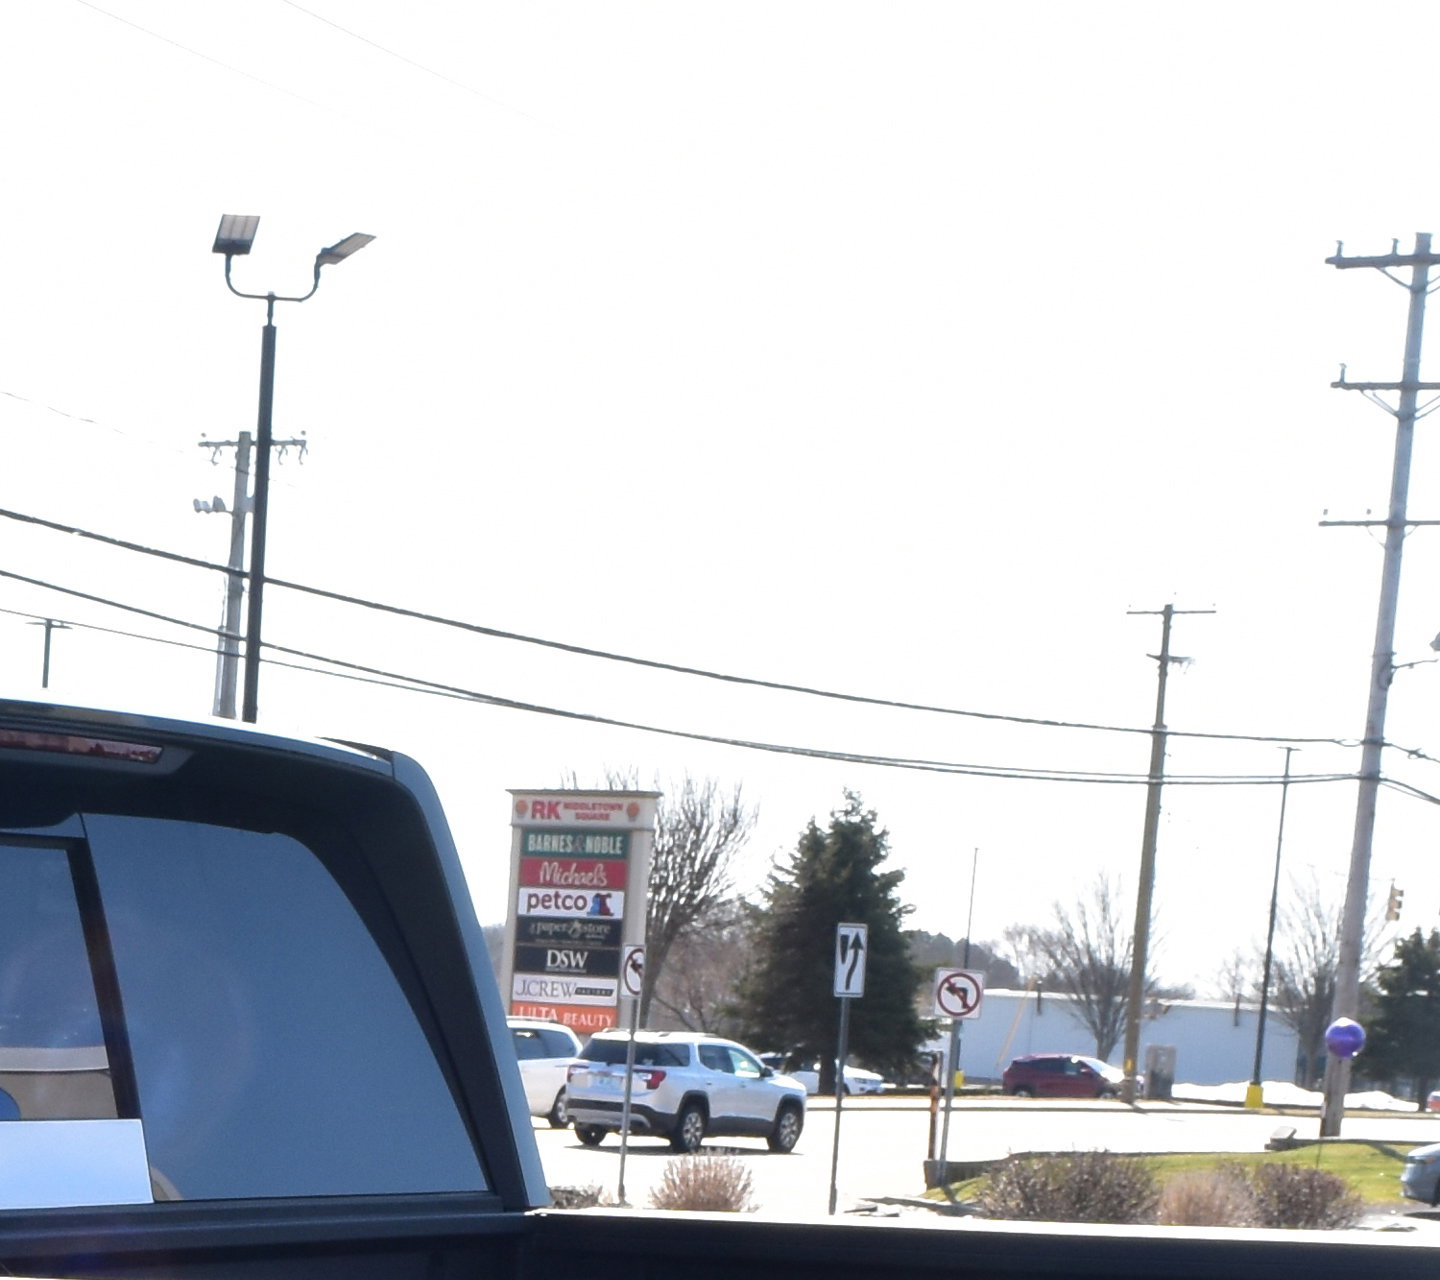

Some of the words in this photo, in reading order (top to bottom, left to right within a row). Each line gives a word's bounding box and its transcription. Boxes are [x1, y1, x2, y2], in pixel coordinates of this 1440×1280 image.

[531, 800, 561, 820] RK
[563, 802, 623, 811] MIDDLETOWN
[575, 812, 610, 821] SQUARE
[528, 834, 570, 852] BARNES
[585, 835, 622, 854] NOBLE
[540, 861, 607, 887] Michaels
[526, 891, 588, 914] petco
[547, 949, 588, 969] DSW
[516, 978, 576, 998] J.CREW
[562, 1013, 613, 1026] BEAUTY
